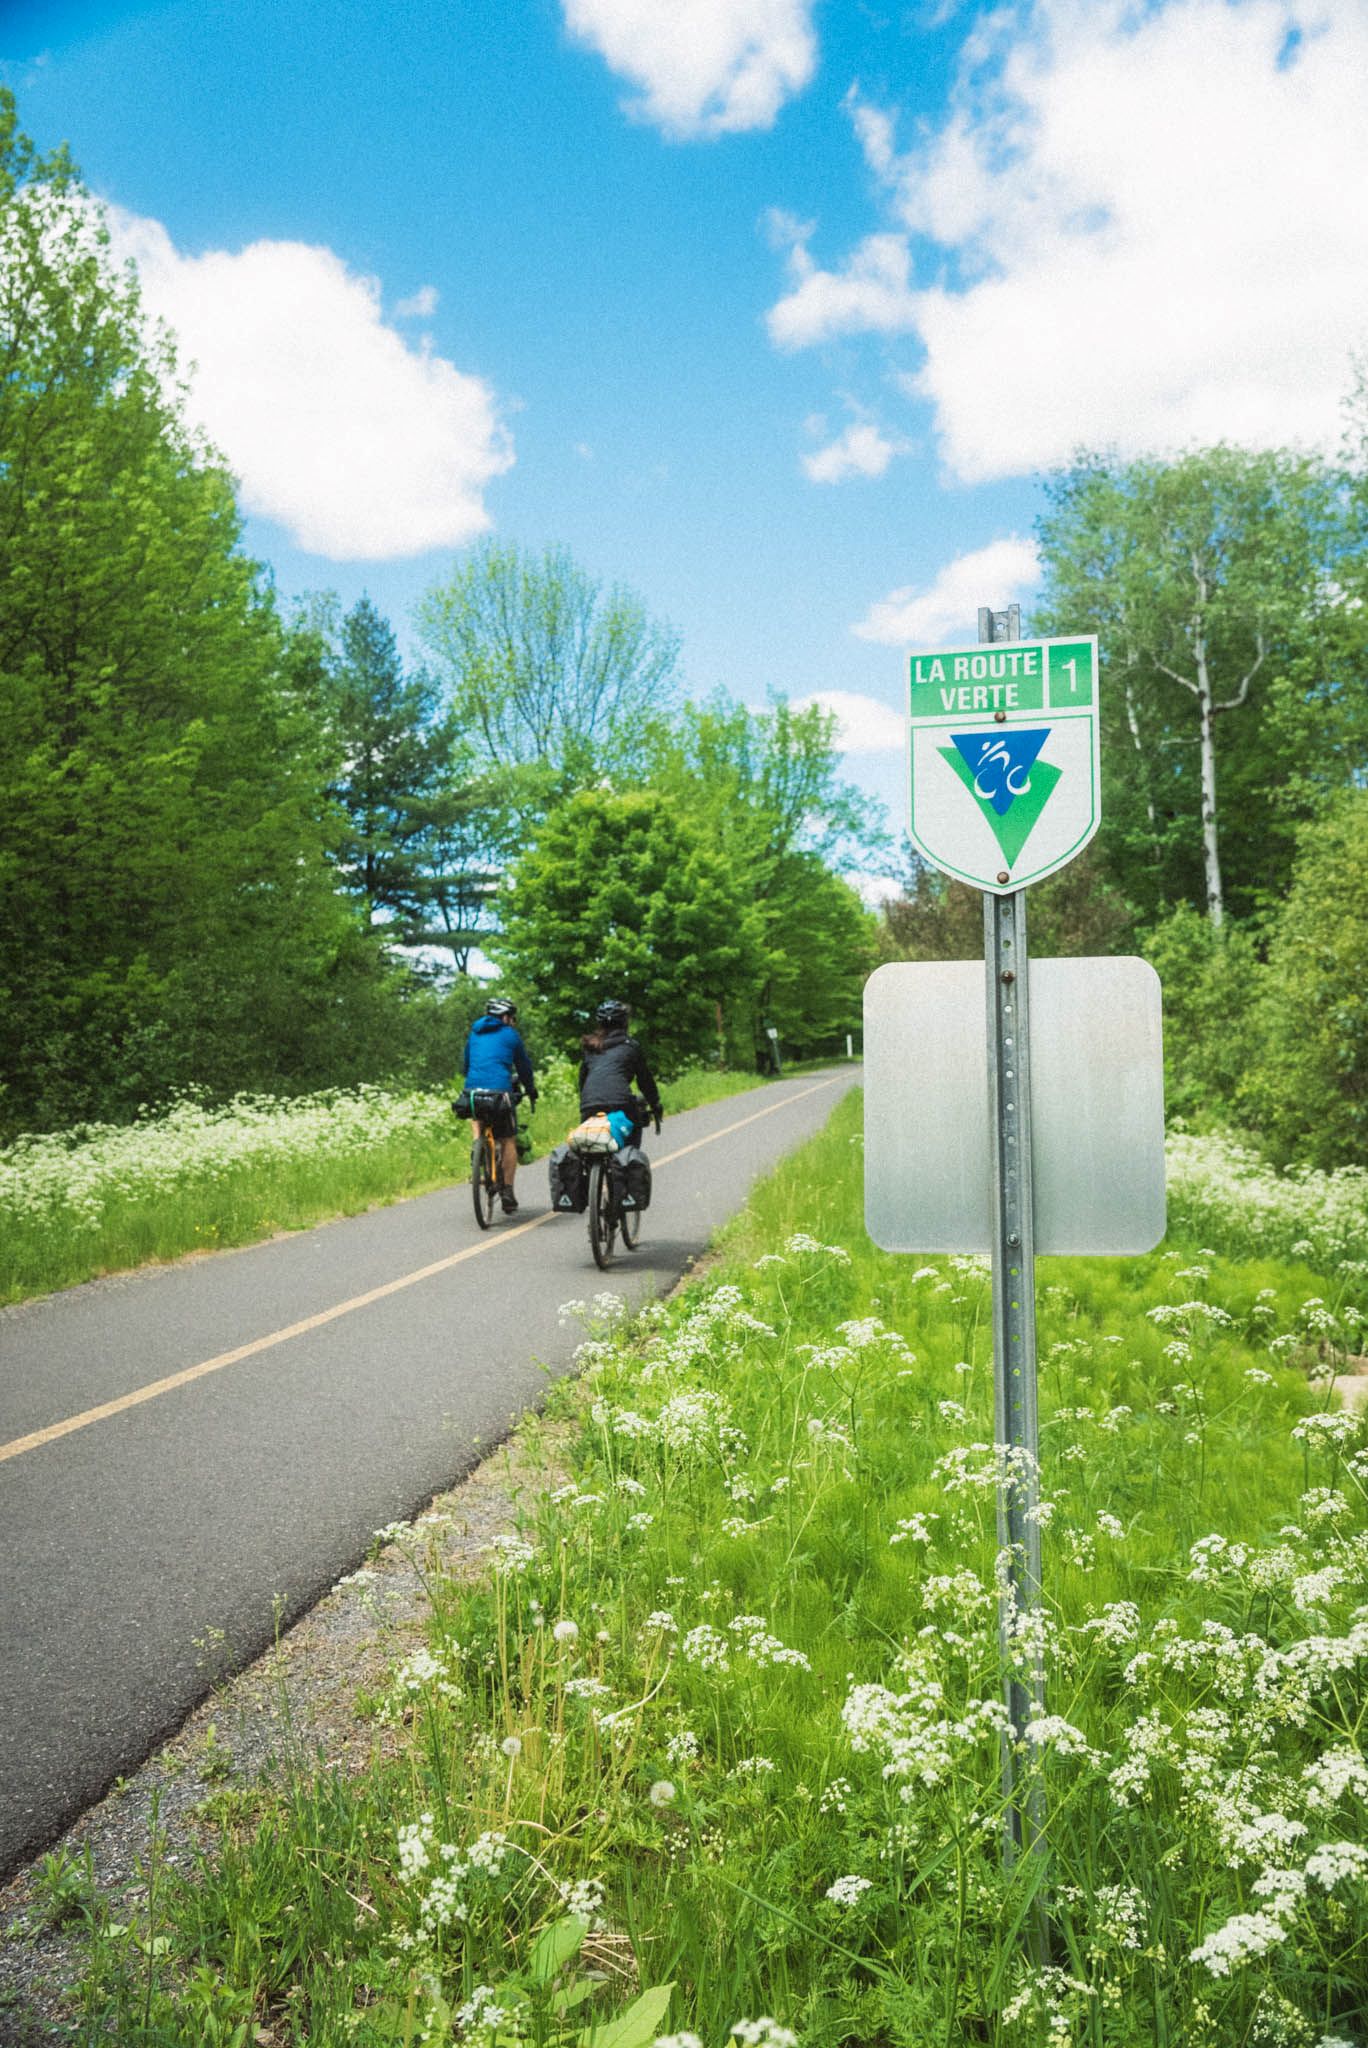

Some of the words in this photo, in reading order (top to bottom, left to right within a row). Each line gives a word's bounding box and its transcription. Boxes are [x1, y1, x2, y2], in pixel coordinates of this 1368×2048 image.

[915, 659, 946, 684] LA
[954, 652, 1037, 681] ROUTE
[1061, 658, 1077, 693] 1
[940, 683, 1019, 711] VERTE
